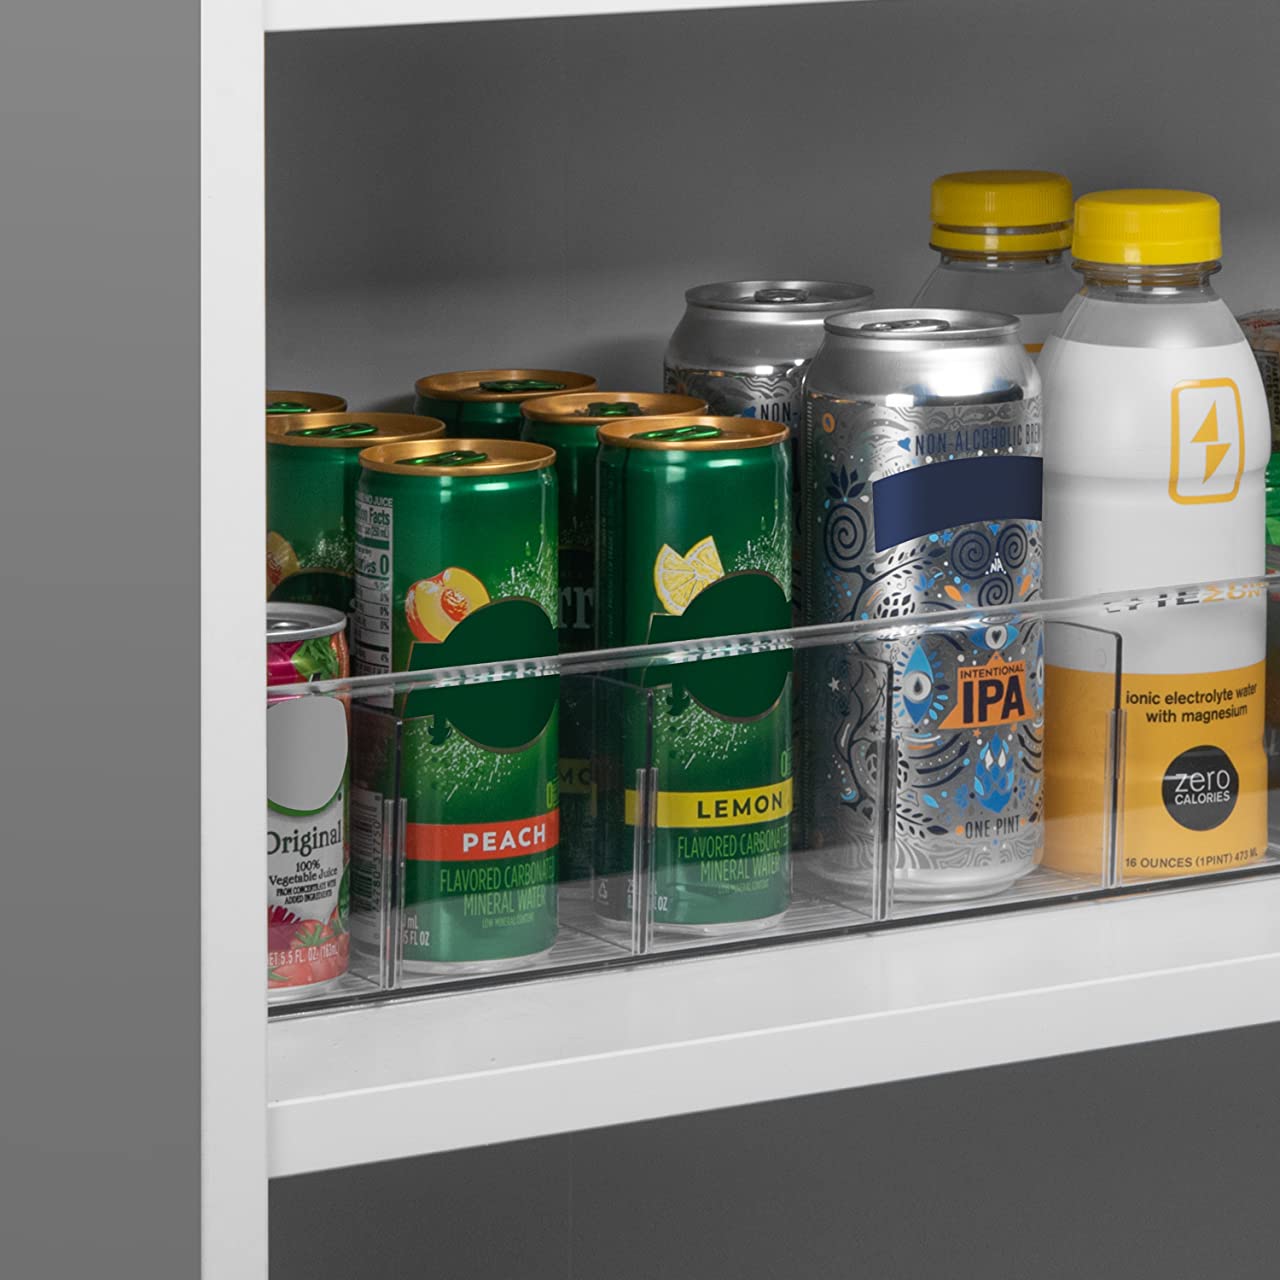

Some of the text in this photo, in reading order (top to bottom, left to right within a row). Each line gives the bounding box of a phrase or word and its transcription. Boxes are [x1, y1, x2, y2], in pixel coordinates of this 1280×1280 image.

[1272, 356, 1280, 425] Nutrition
[915, 425, 1023, 456] NON-ALCOHOLIC
[370, 508, 390, 526] Facts
[380, 554, 389, 576] 0
[960, 664, 1024, 679] INTENTIONAL
[963, 675, 1025, 724] IPA
[1126, 682, 1257, 706] ionic electrolyte water
[1146, 704, 1248, 724] with magnesium
[1174, 769, 1231, 793] zero
[697, 791, 783, 819] LEMON
[1174, 791, 1231, 805] CALORIES
[267, 818, 342, 857] Original
[463, 823, 546, 852] PEACH
[965, 815, 1020, 839] ONE PINT
[678, 834, 737, 858] FLAVORED
[296, 859, 321, 873] 100%
[700, 853, 780, 882] MINERAL WATER
[1125, 858, 1137, 868] 16
[1140, 857, 1192, 868] OUNCES
[1235, 851, 1249, 862] 473
[268, 867, 338, 887] Vegetable Juice
[440, 867, 500, 893] FLAVORED
[464, 885, 546, 916] MINERAL WATER
[407, 916, 417, 929] mL
[409, 931, 430, 946] FL OZ
[268, 952, 279, 966] ET
[281, 950, 293, 965] 5.5
